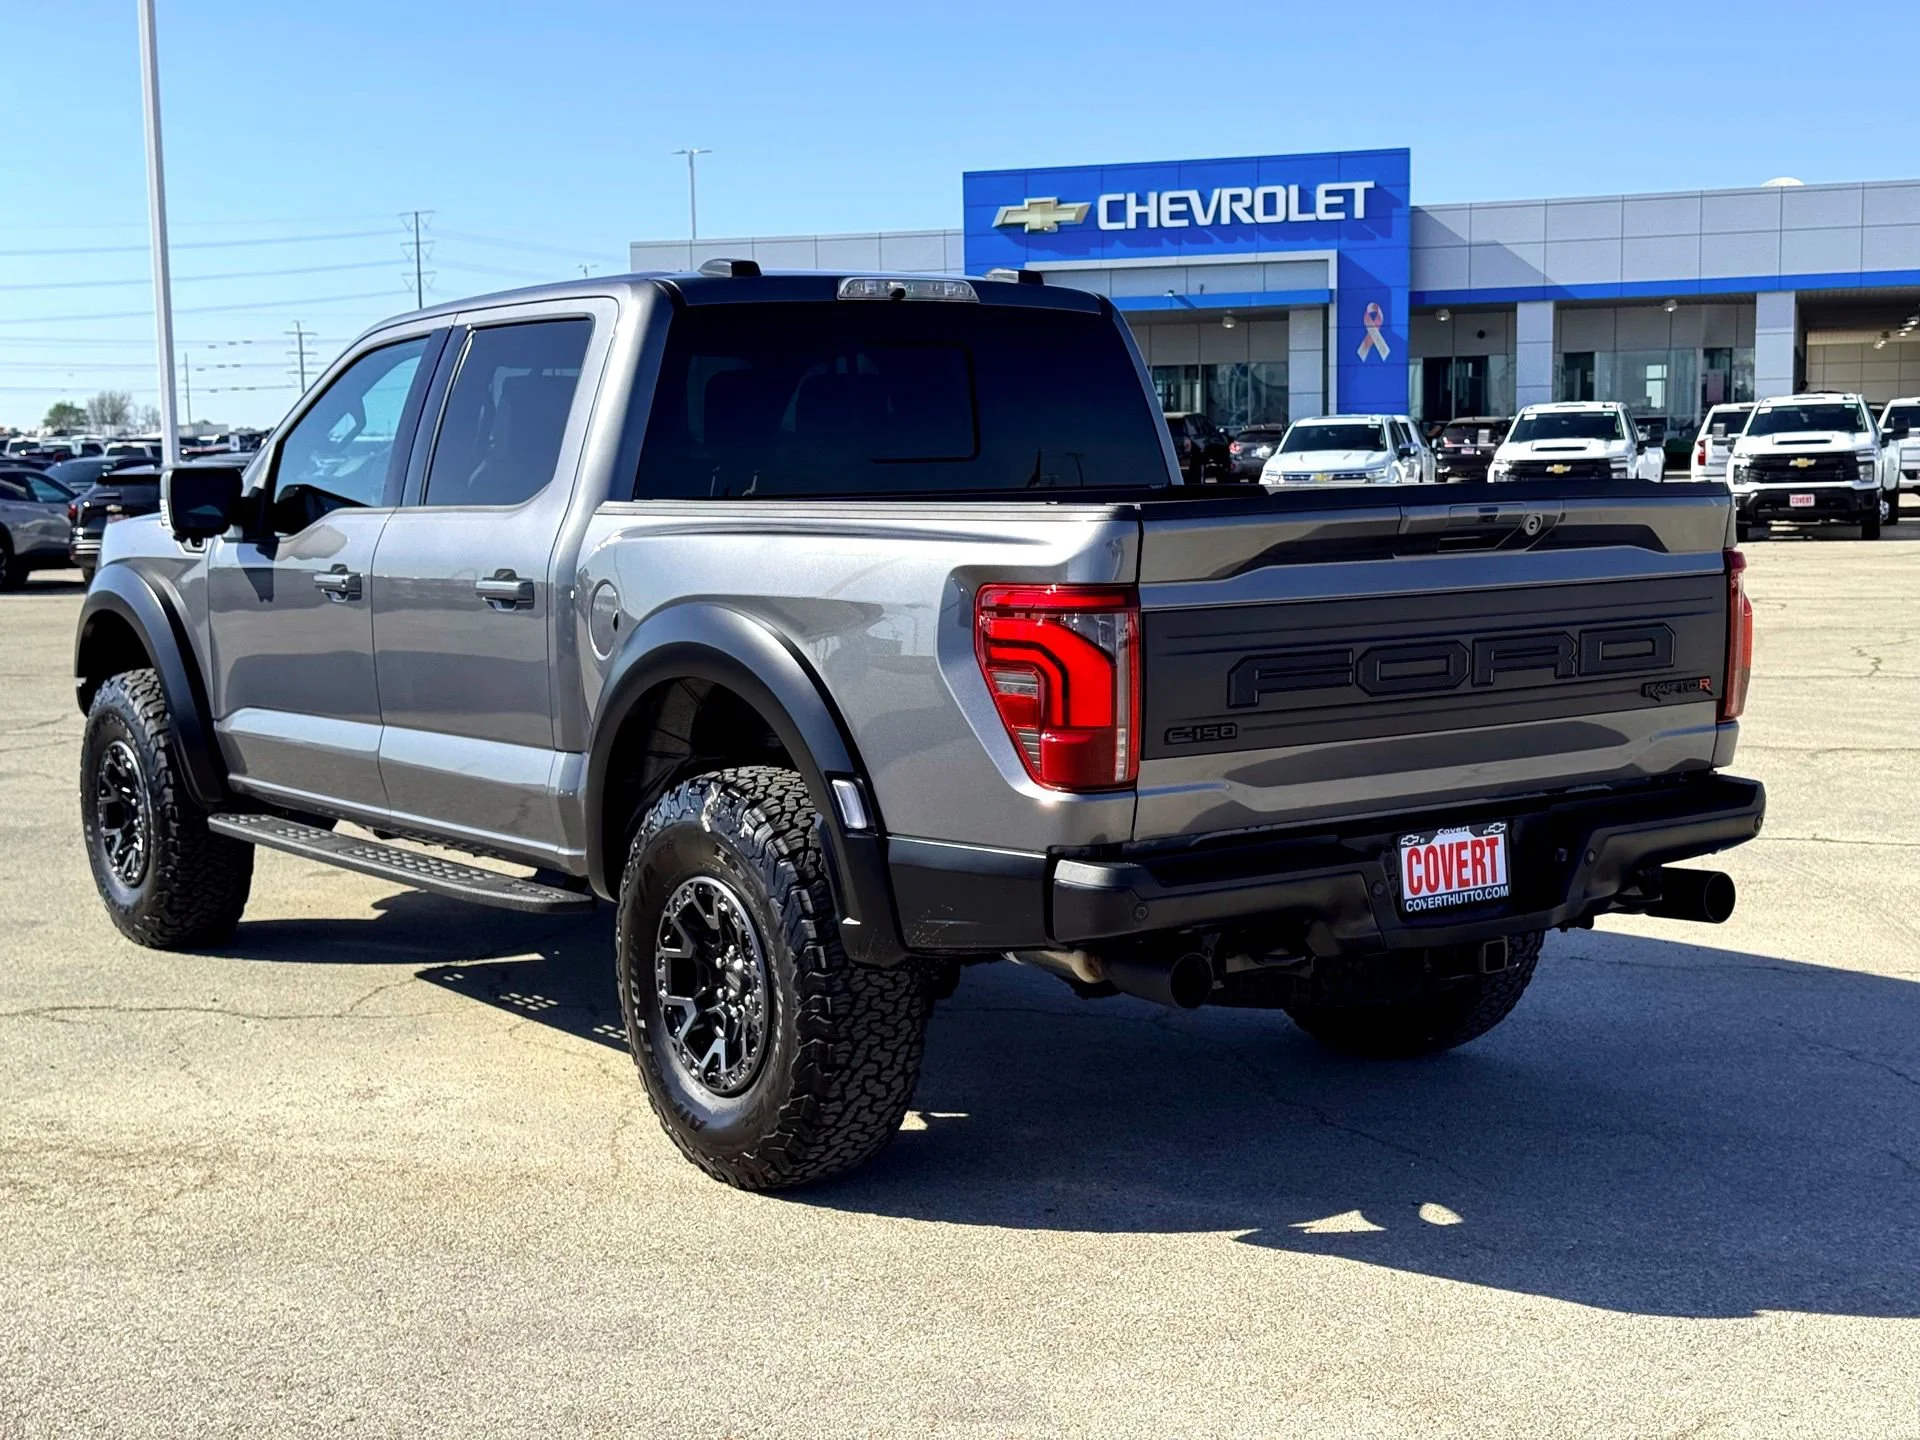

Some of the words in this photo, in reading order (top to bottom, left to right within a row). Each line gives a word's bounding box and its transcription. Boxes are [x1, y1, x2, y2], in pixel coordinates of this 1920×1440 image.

[1097, 181, 1375, 231] CHEVROLET
[1227, 622, 1676, 709] FORD
[1642, 676, 1713, 703] RAPTOR
[1437, 825, 1470, 836] Covert
[1407, 836, 1499, 896] COVERT
[1406, 885, 1509, 912] COVERTHUTTO.COM
